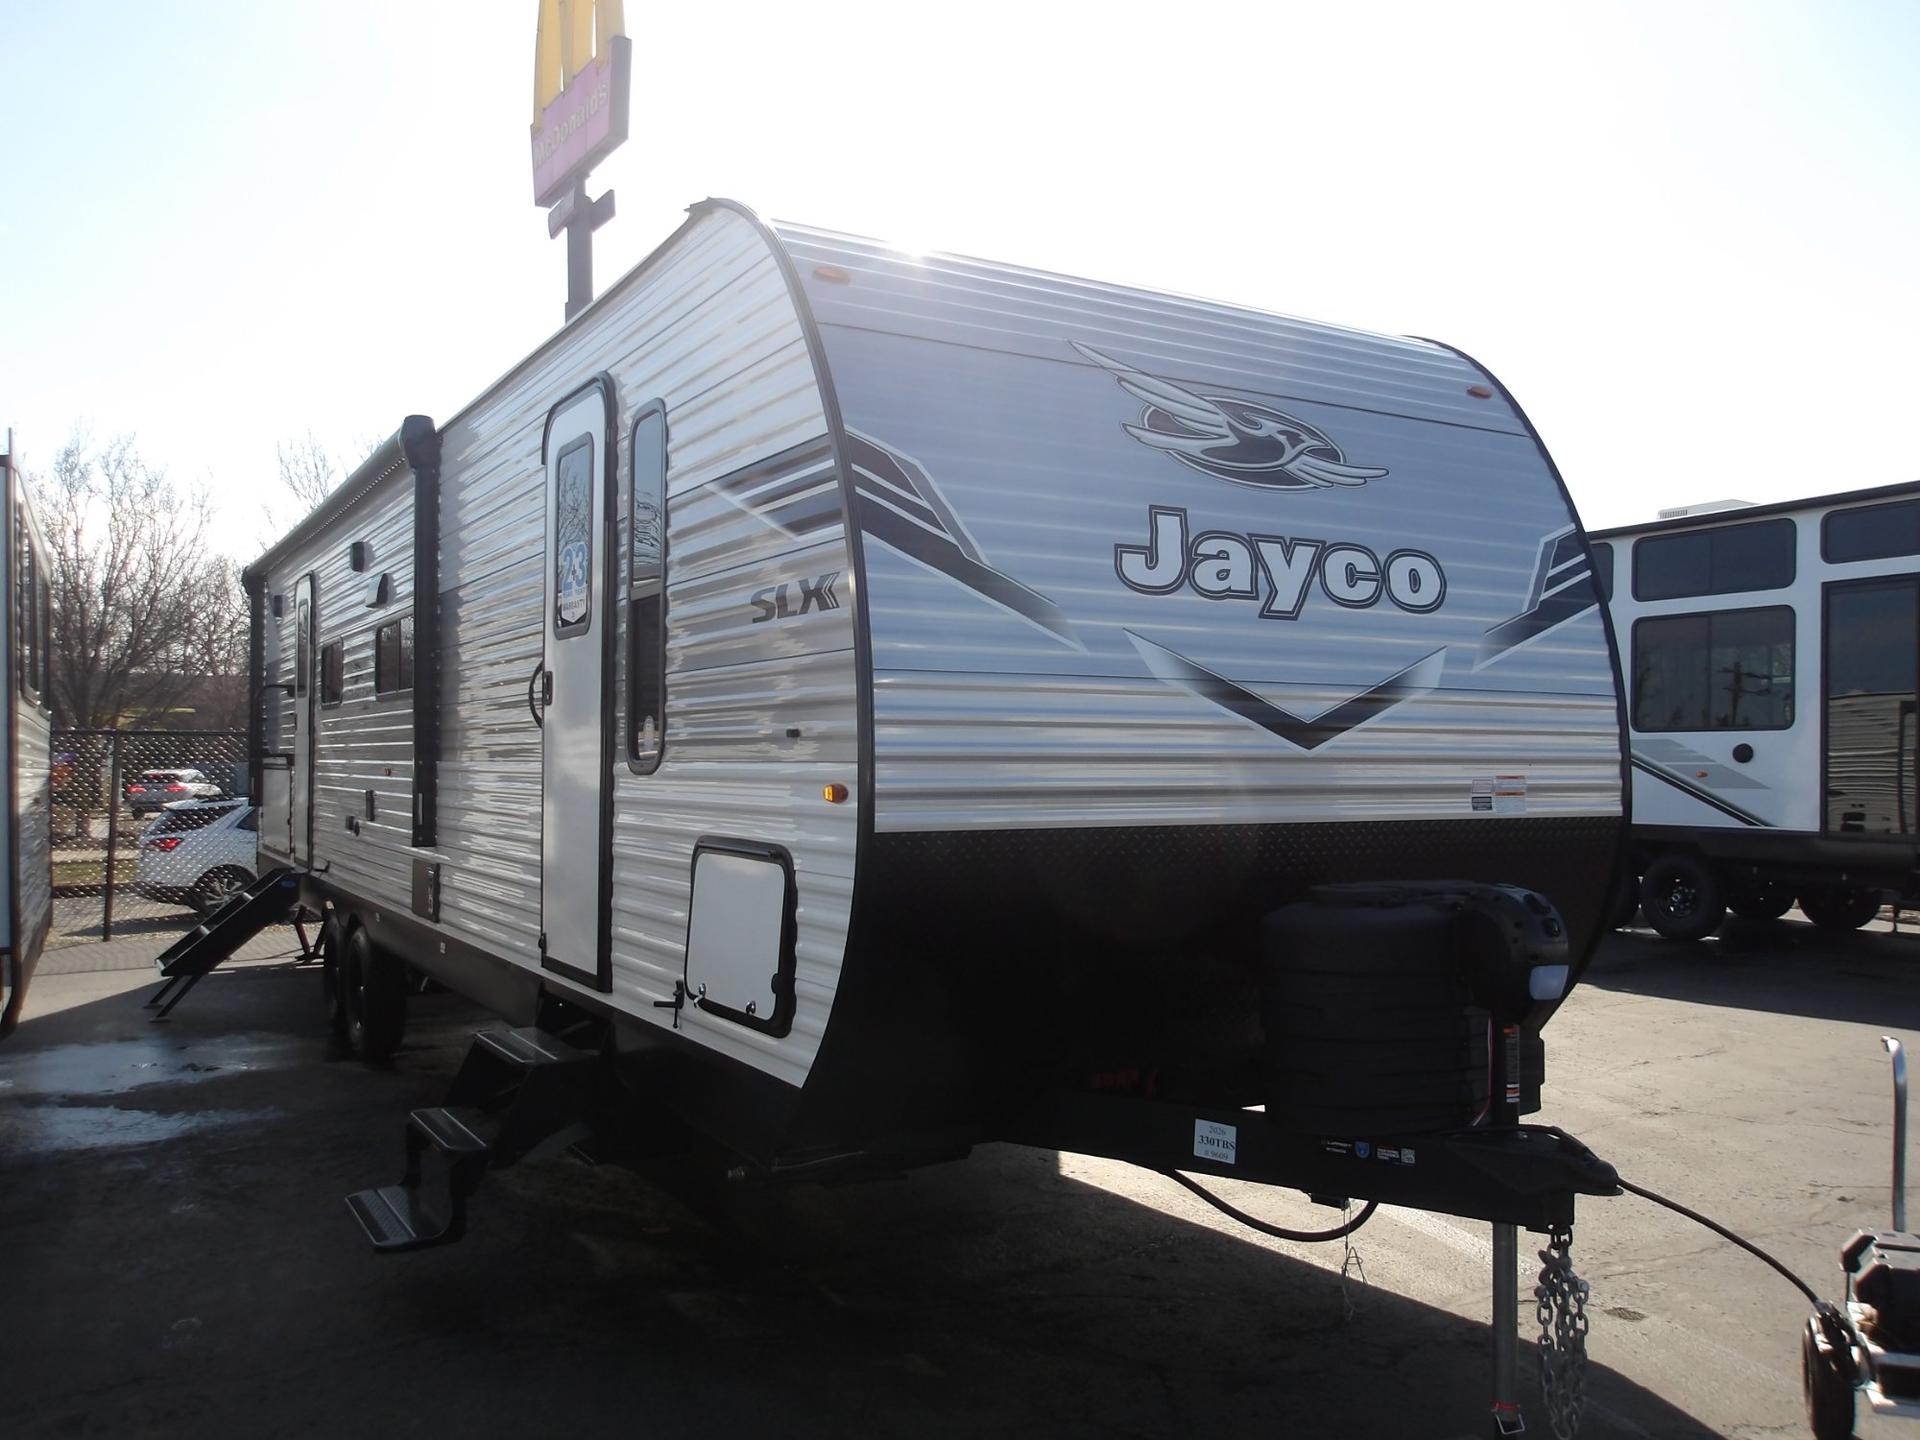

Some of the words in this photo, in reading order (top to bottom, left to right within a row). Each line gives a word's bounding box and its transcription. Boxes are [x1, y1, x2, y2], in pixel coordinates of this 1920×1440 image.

[1114, 504, 1447, 621] Jayco
[751, 571, 840, 624] SLX
[1198, 1135, 1235, 1150] 330TBS
